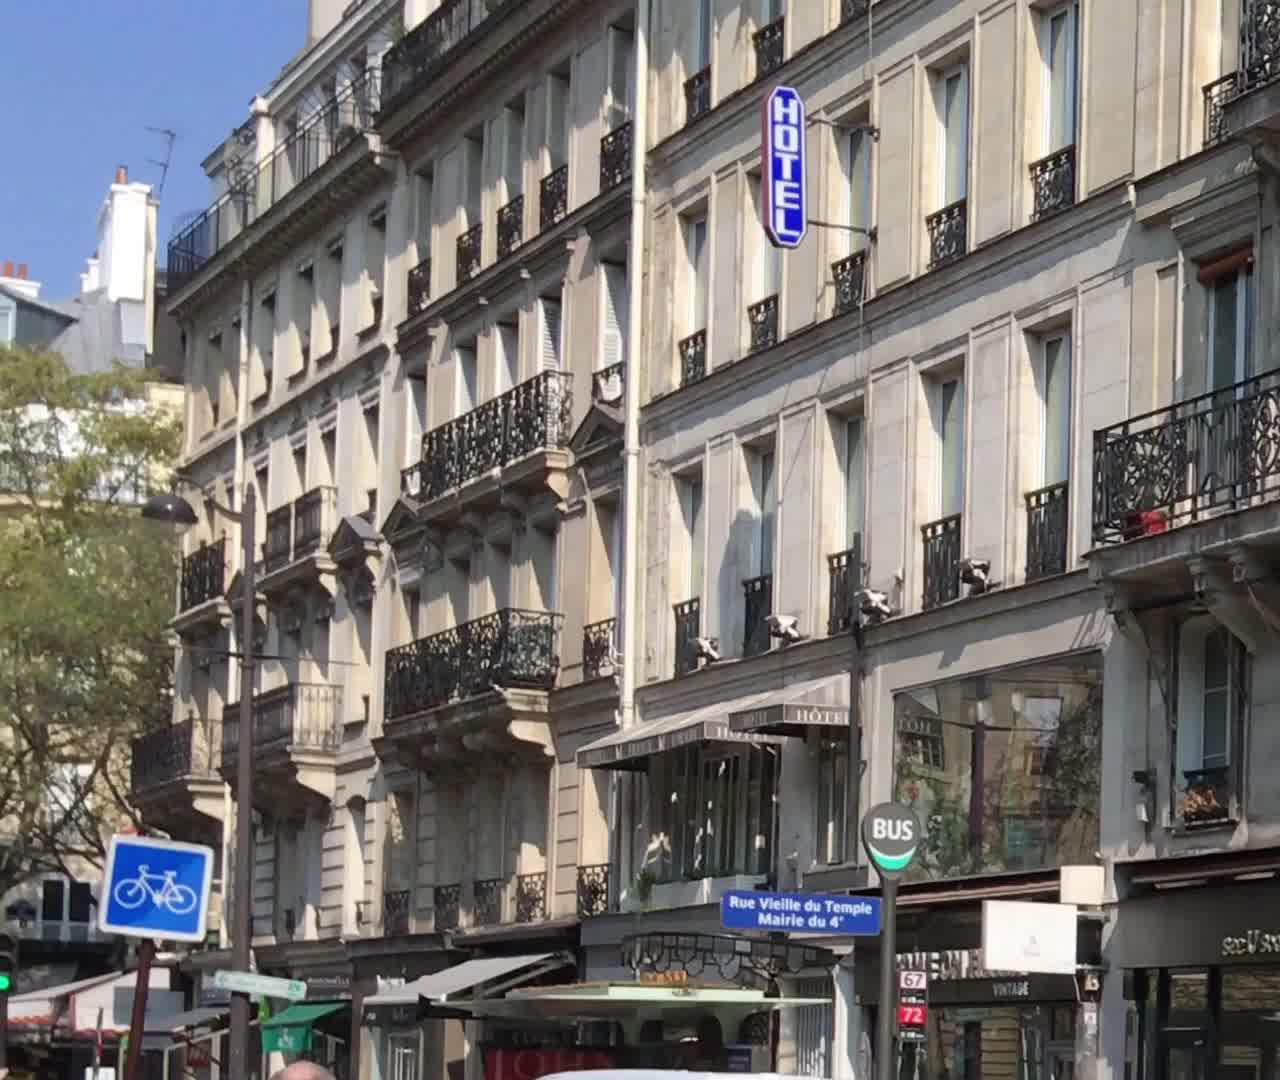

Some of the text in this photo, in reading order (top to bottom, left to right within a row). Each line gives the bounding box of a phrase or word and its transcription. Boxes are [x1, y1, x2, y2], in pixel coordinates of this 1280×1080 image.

[773, 96, 800, 236] HOTEL
[872, 817, 913, 841] BUS
[729, 895, 873, 917] Rue Vieille du Temple
[757, 912, 805, 928] Mairie
[808, 914, 826, 928] du
[903, 974, 923, 988] 67
[904, 1007, 924, 1023] 72
